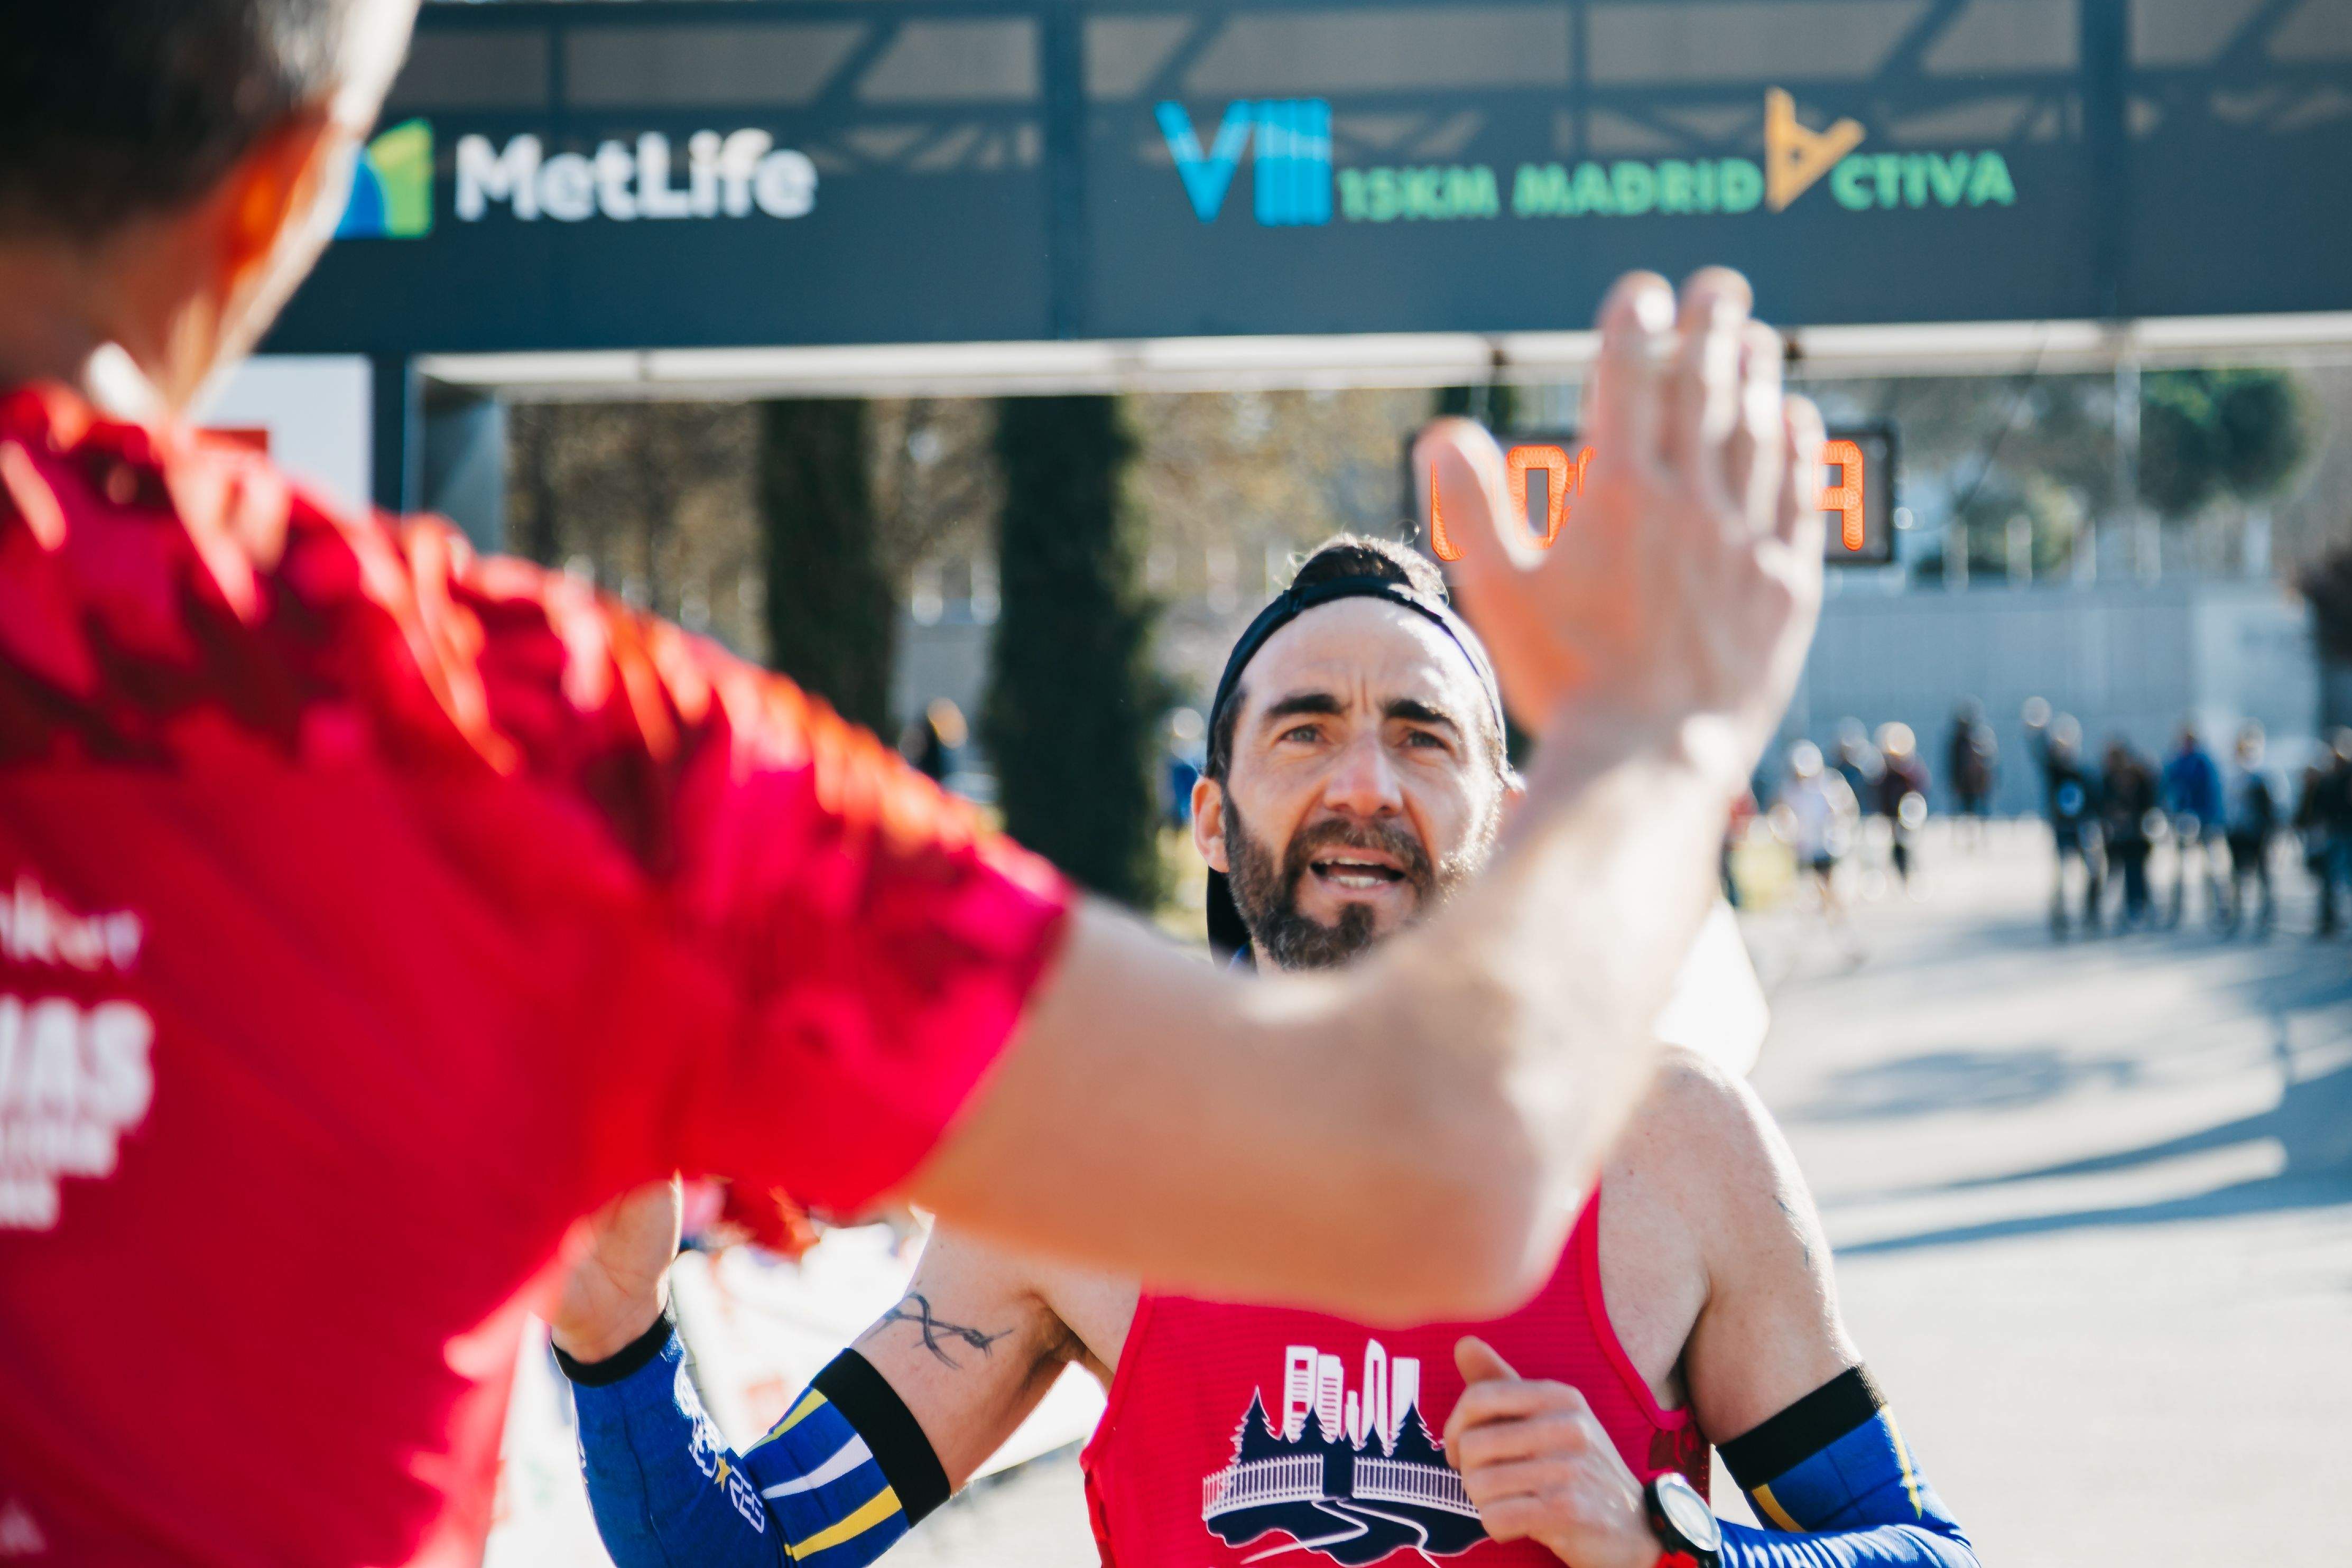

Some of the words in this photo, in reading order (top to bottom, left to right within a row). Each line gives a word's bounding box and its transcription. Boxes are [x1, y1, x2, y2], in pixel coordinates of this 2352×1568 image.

[456, 128, 818, 222] MetLife
[1338, 164, 1499, 223] 15KM
[1512, 157, 1764, 219] MADRID
